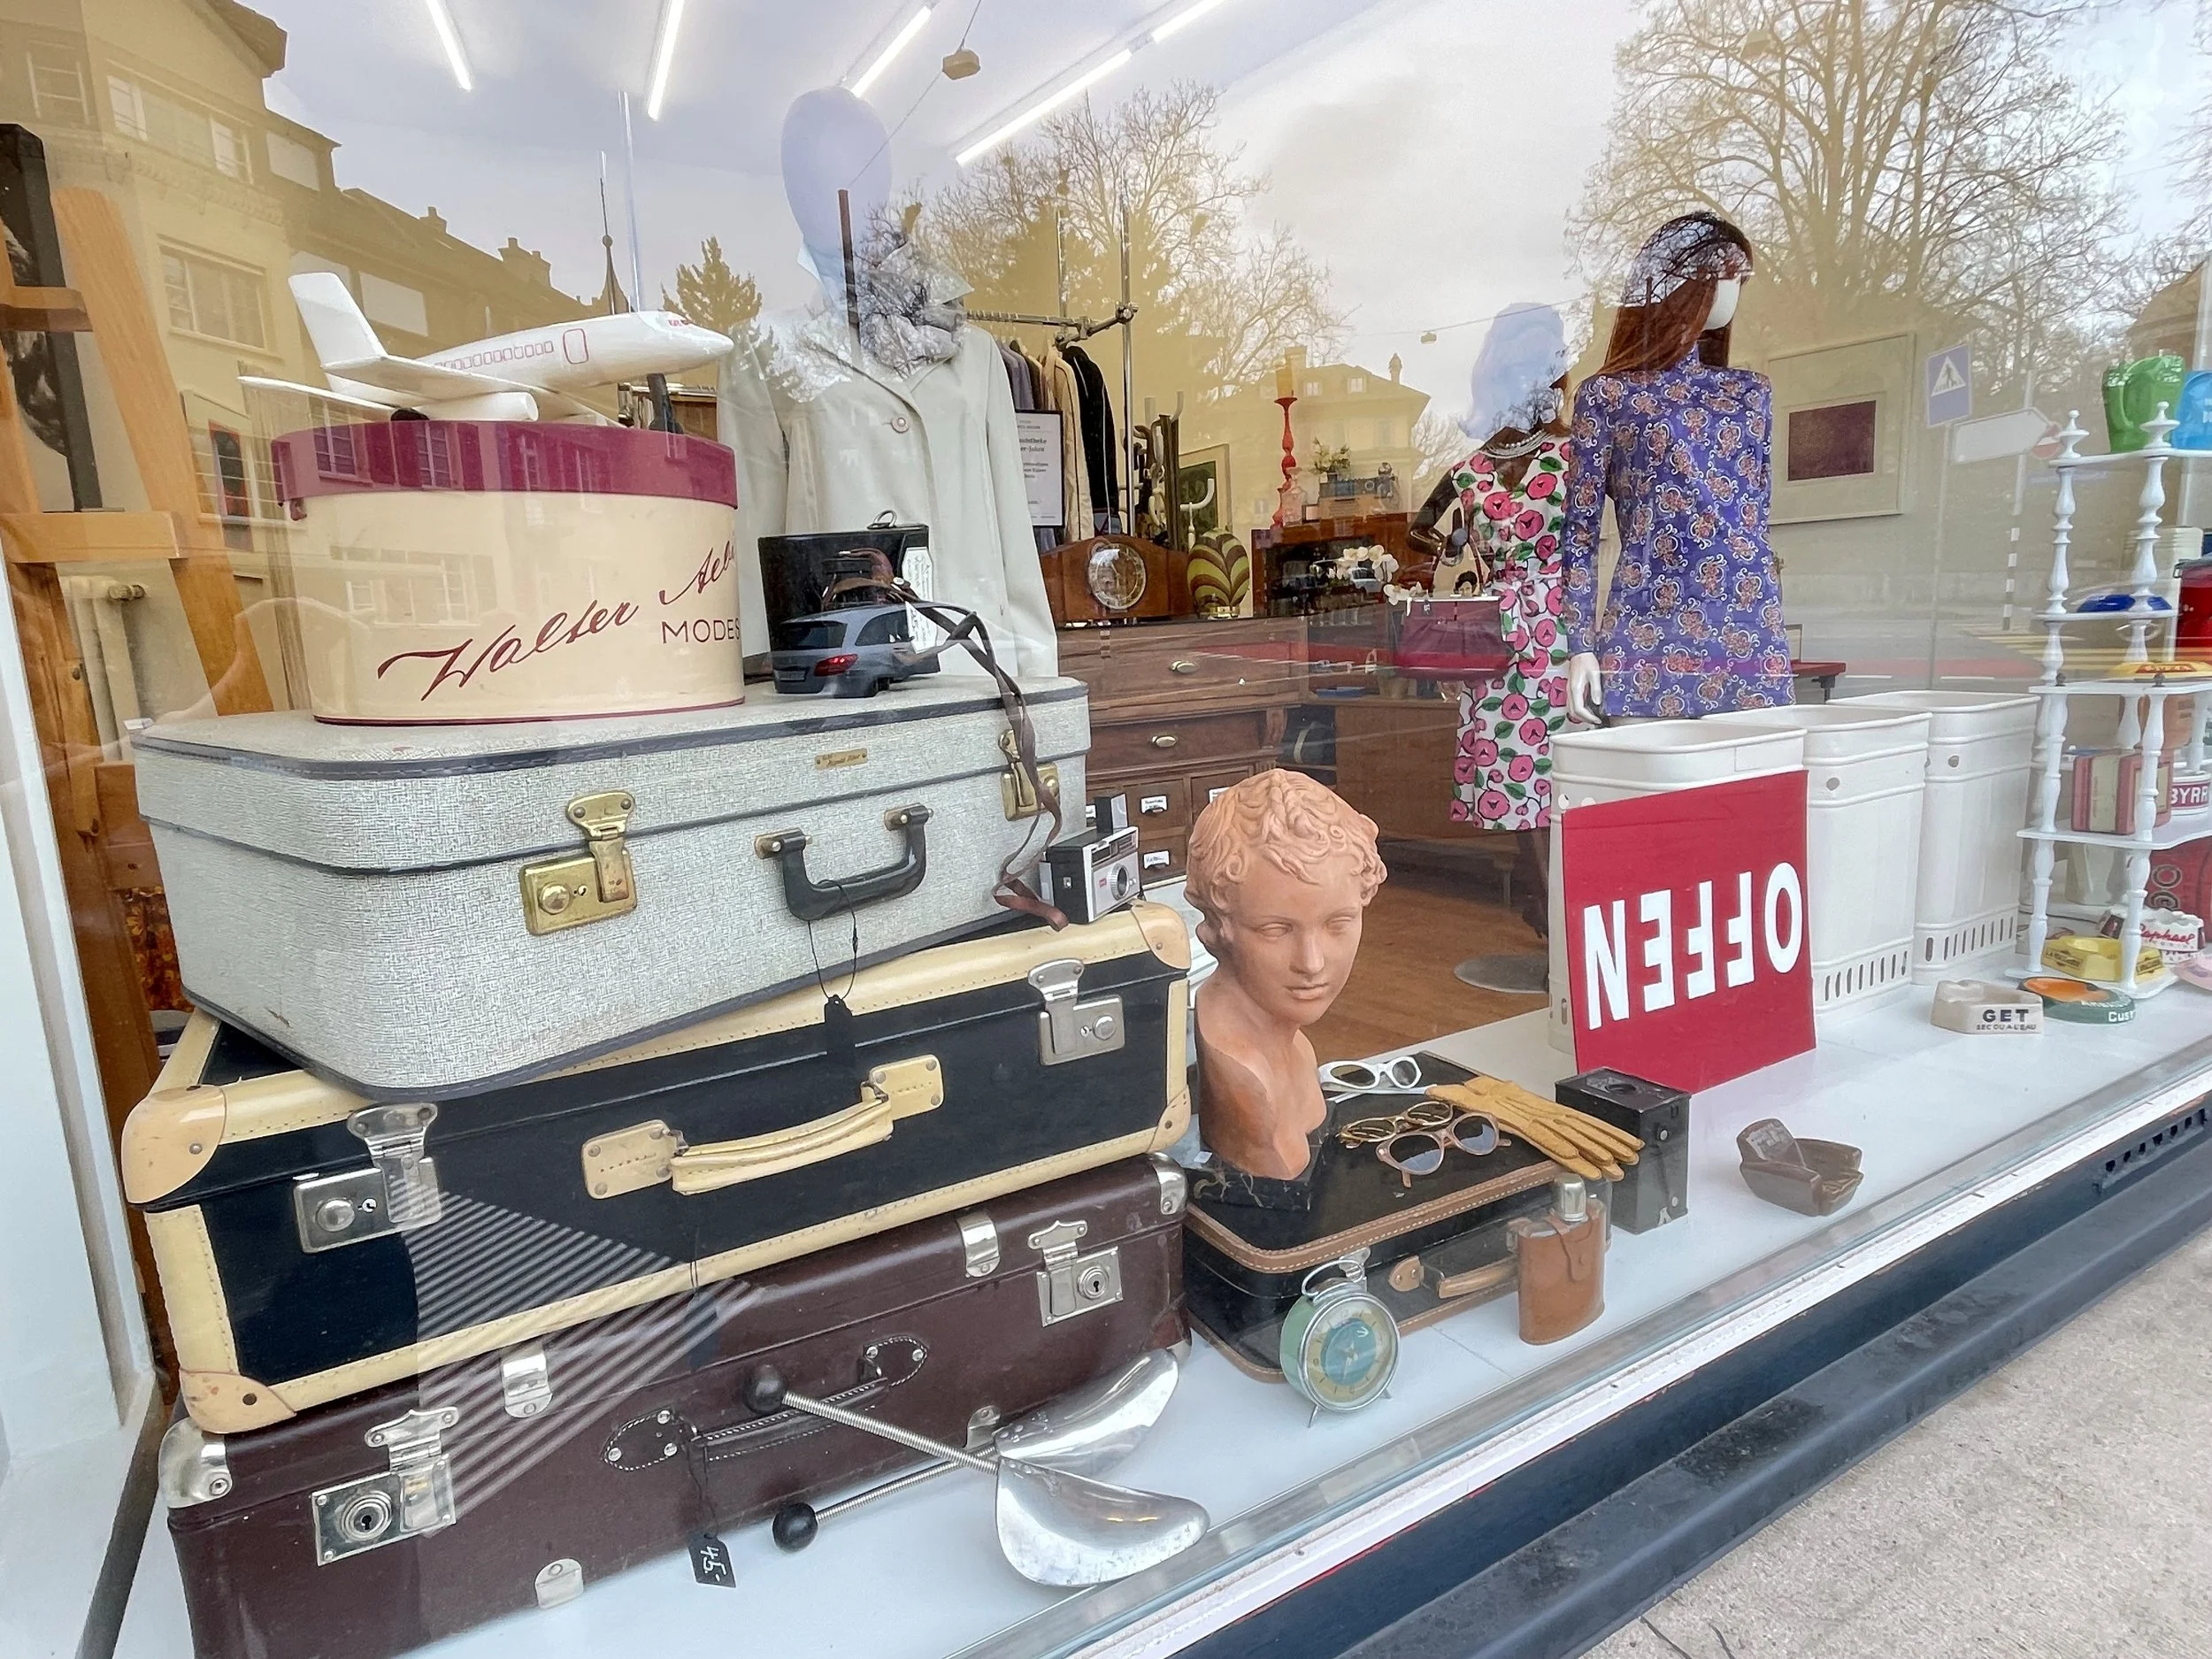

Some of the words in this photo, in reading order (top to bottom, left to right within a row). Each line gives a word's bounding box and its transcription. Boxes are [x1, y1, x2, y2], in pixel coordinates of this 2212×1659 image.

[377, 599, 640, 702] Walter
[661, 618, 741, 644] MODES
[1584, 862, 1803, 1030] OFFEN
[1983, 1010, 2030, 1022] GET
